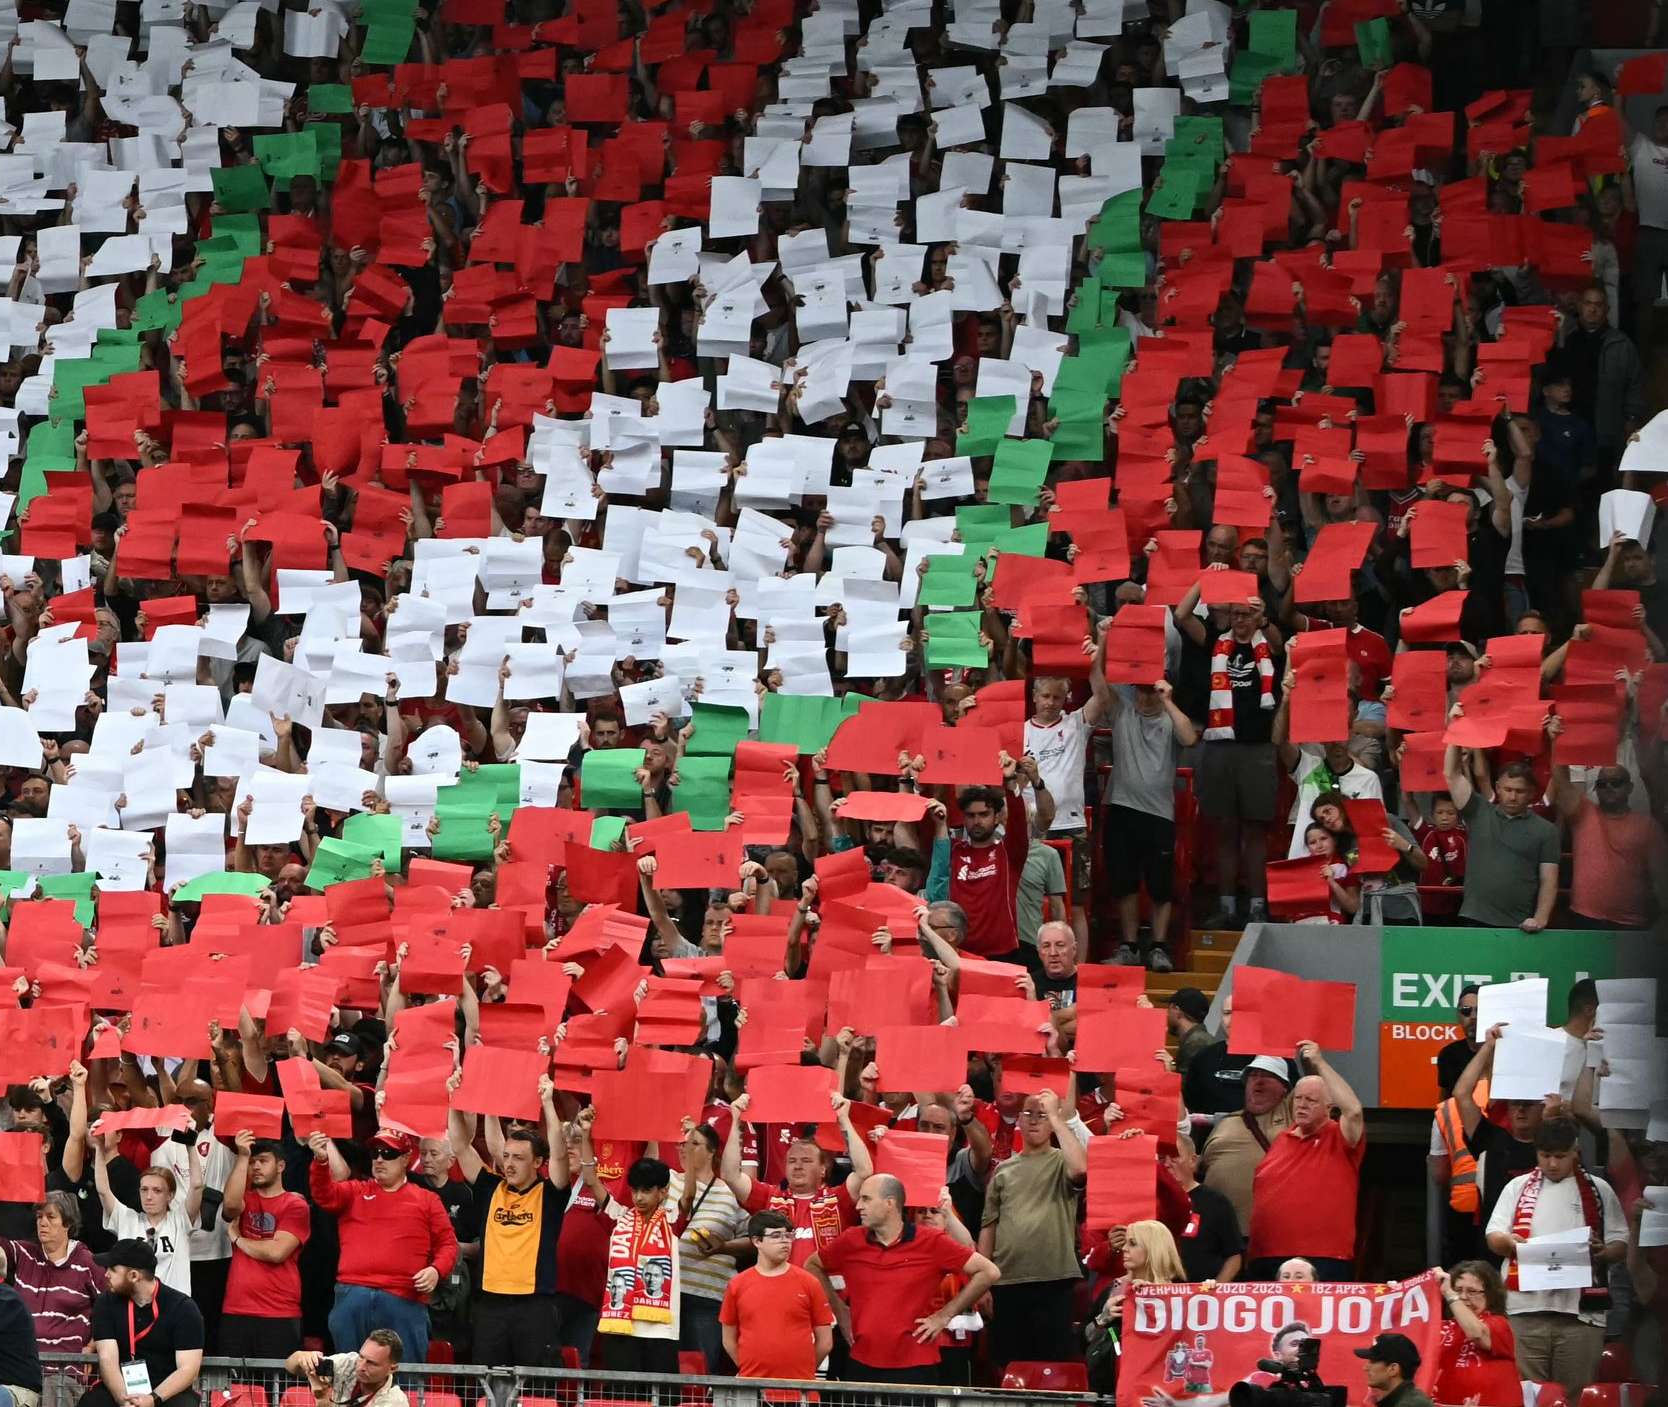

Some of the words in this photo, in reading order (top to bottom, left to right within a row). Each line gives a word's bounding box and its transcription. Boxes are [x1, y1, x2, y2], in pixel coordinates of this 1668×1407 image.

[1392, 1024, 1458, 1041] BLOCK
[493, 1207, 534, 1223] Carlsberg
[1215, 1283, 1284, 1294] 2020-2025
[1335, 1283, 1367, 1295] APPS
[633, 1296, 670, 1307] DARWIN
[1134, 1294, 1296, 1333] DIOGO
[1311, 1285, 1430, 1334] JOTA
